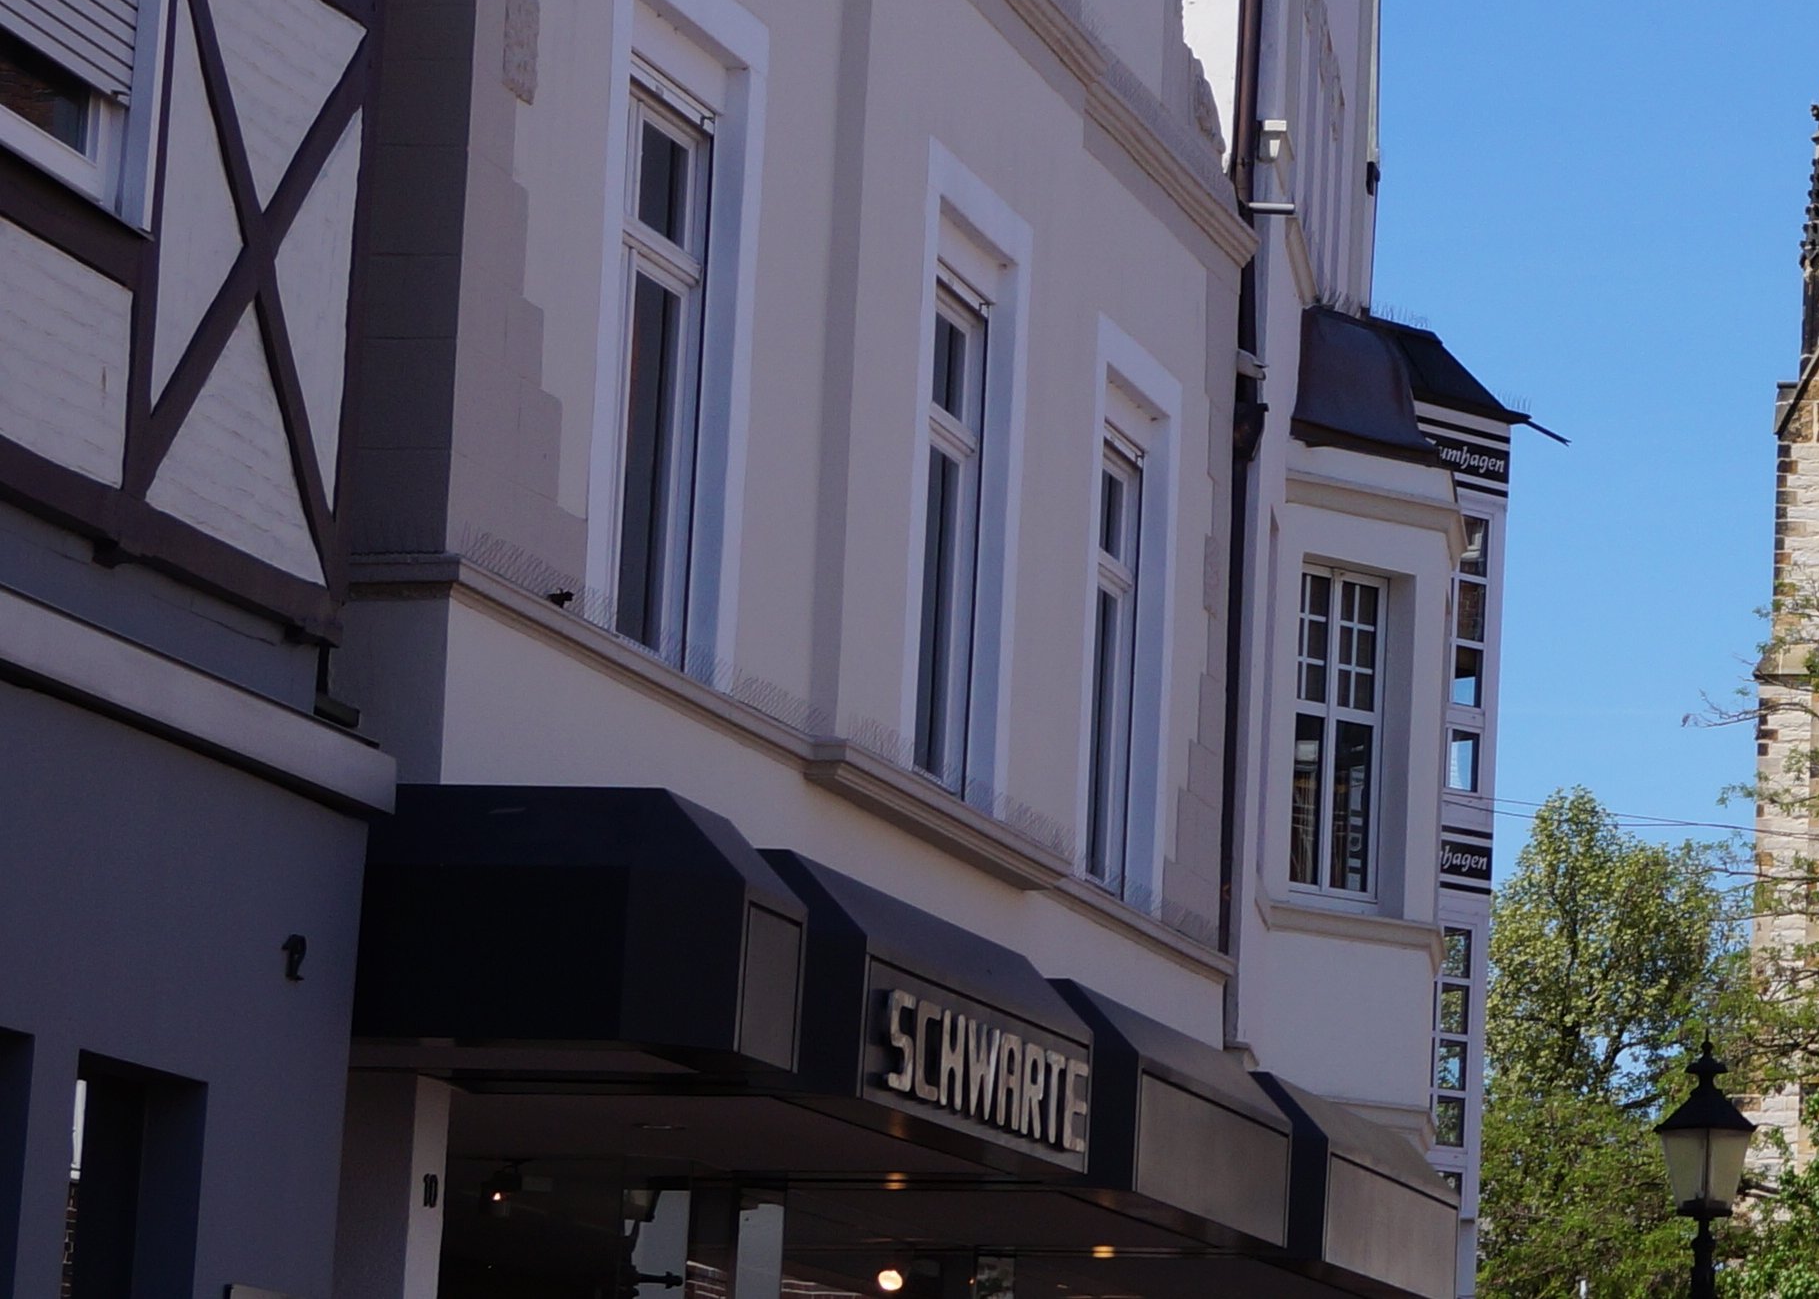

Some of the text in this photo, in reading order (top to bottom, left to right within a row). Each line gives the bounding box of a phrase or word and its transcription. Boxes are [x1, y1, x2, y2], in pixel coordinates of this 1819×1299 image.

[1425, 436, 1505, 474] umhagen
[1440, 844, 1488, 873] hagen
[886, 988, 1089, 1153] SCHWARTE
[423, 1172, 438, 1209] 10
